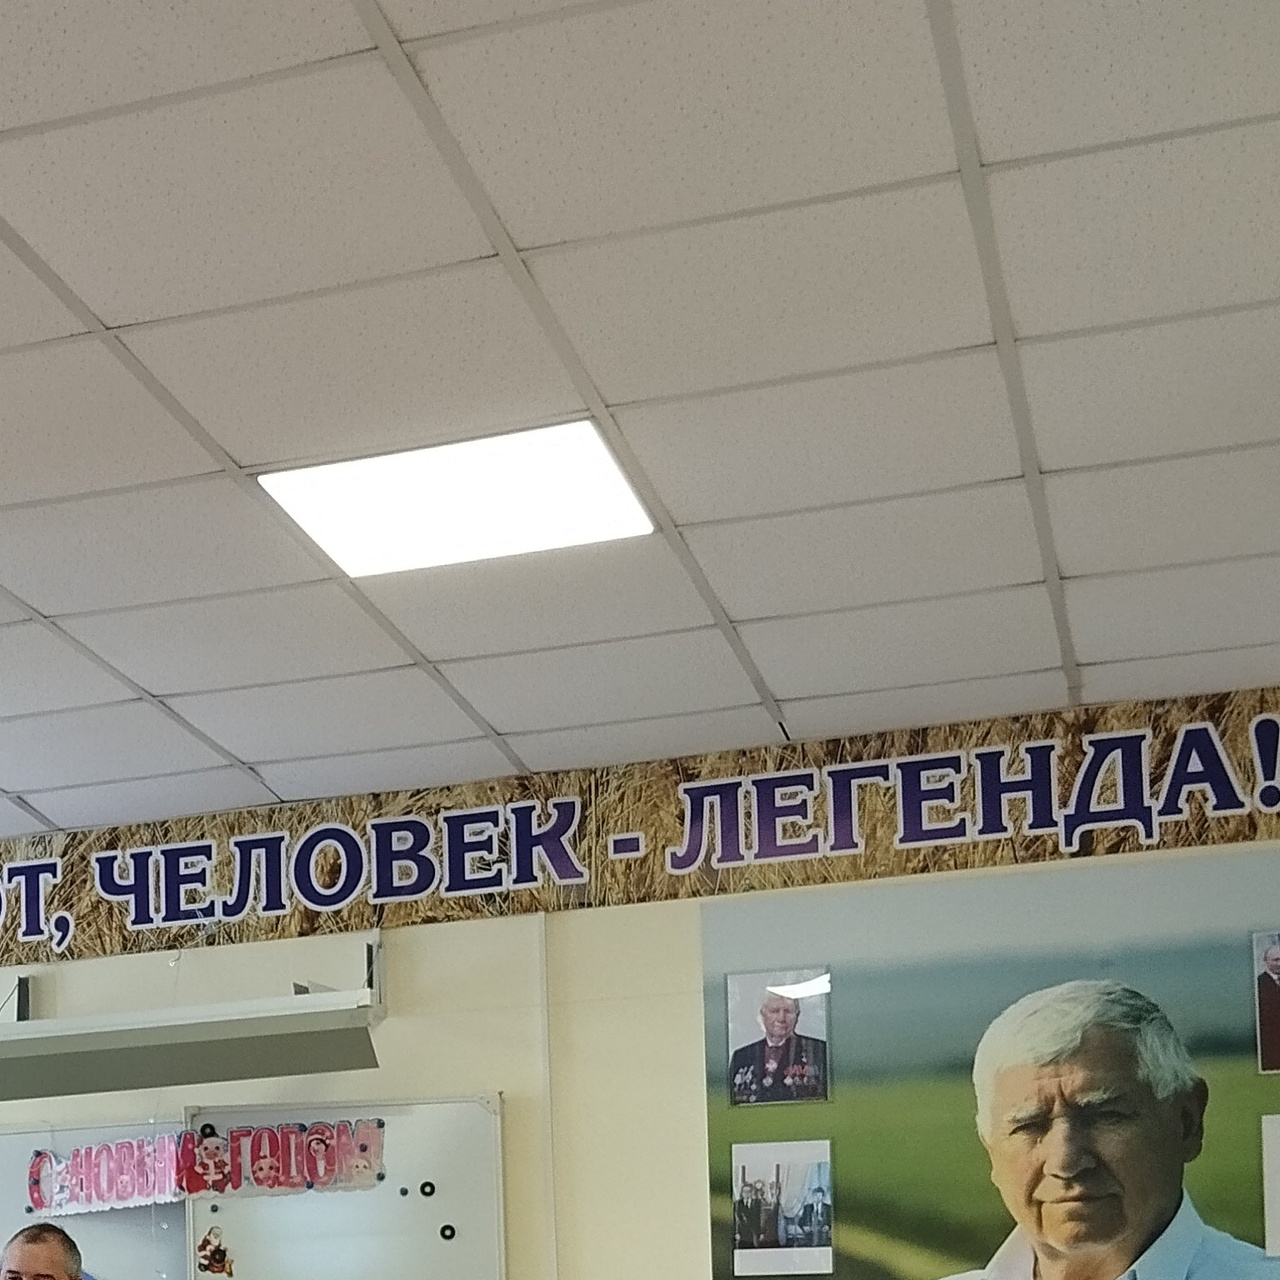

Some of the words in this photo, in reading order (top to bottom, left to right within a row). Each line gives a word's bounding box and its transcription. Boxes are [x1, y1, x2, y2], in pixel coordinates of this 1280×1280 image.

[94, 799, 586, 930] ЧЕЛОВЕК
[610, 834, 644, 857] -
[668, 715, 1280, 873] ЛЕГЕНДА!
